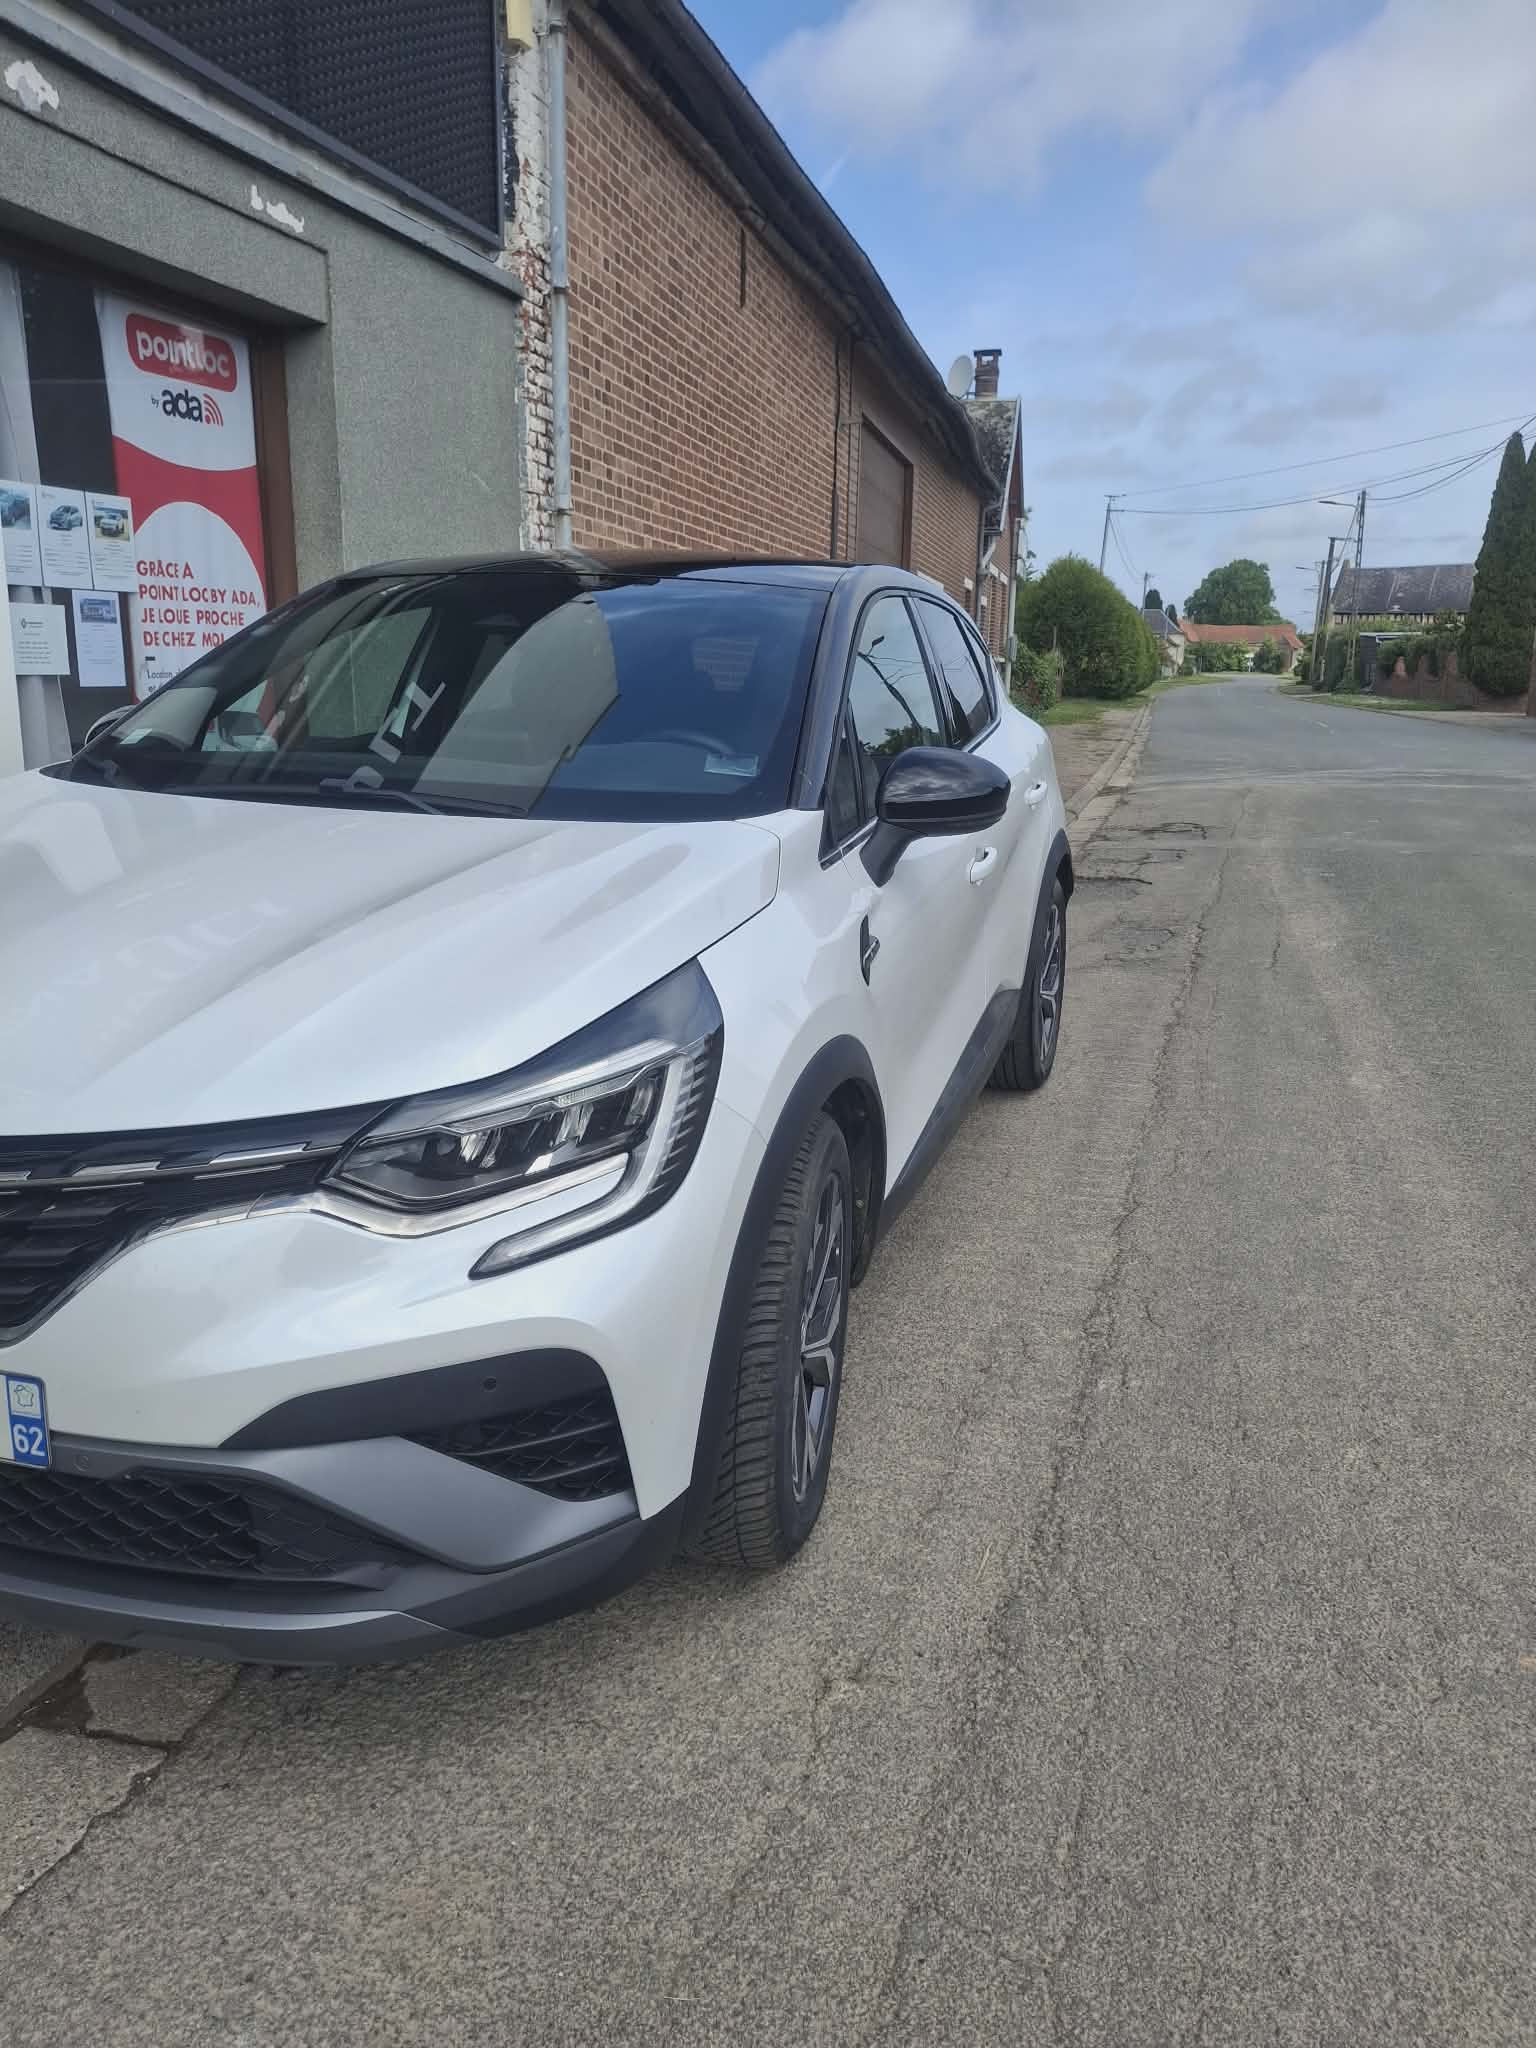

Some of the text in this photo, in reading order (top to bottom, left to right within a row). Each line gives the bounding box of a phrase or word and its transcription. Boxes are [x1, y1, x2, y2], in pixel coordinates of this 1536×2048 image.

[136, 330, 230, 377] pointloc
[161, 389, 203, 422] ada
[139, 583, 179, 601] POINT
[181, 586, 209, 602] LOC
[210, 588, 227, 603] BY
[142, 608, 245, 626] JE LOUE PROCHE
[143, 631, 159, 647] DE
[162, 632, 197, 648] CHEZ
[13, 1423, 46, 1457] 62
